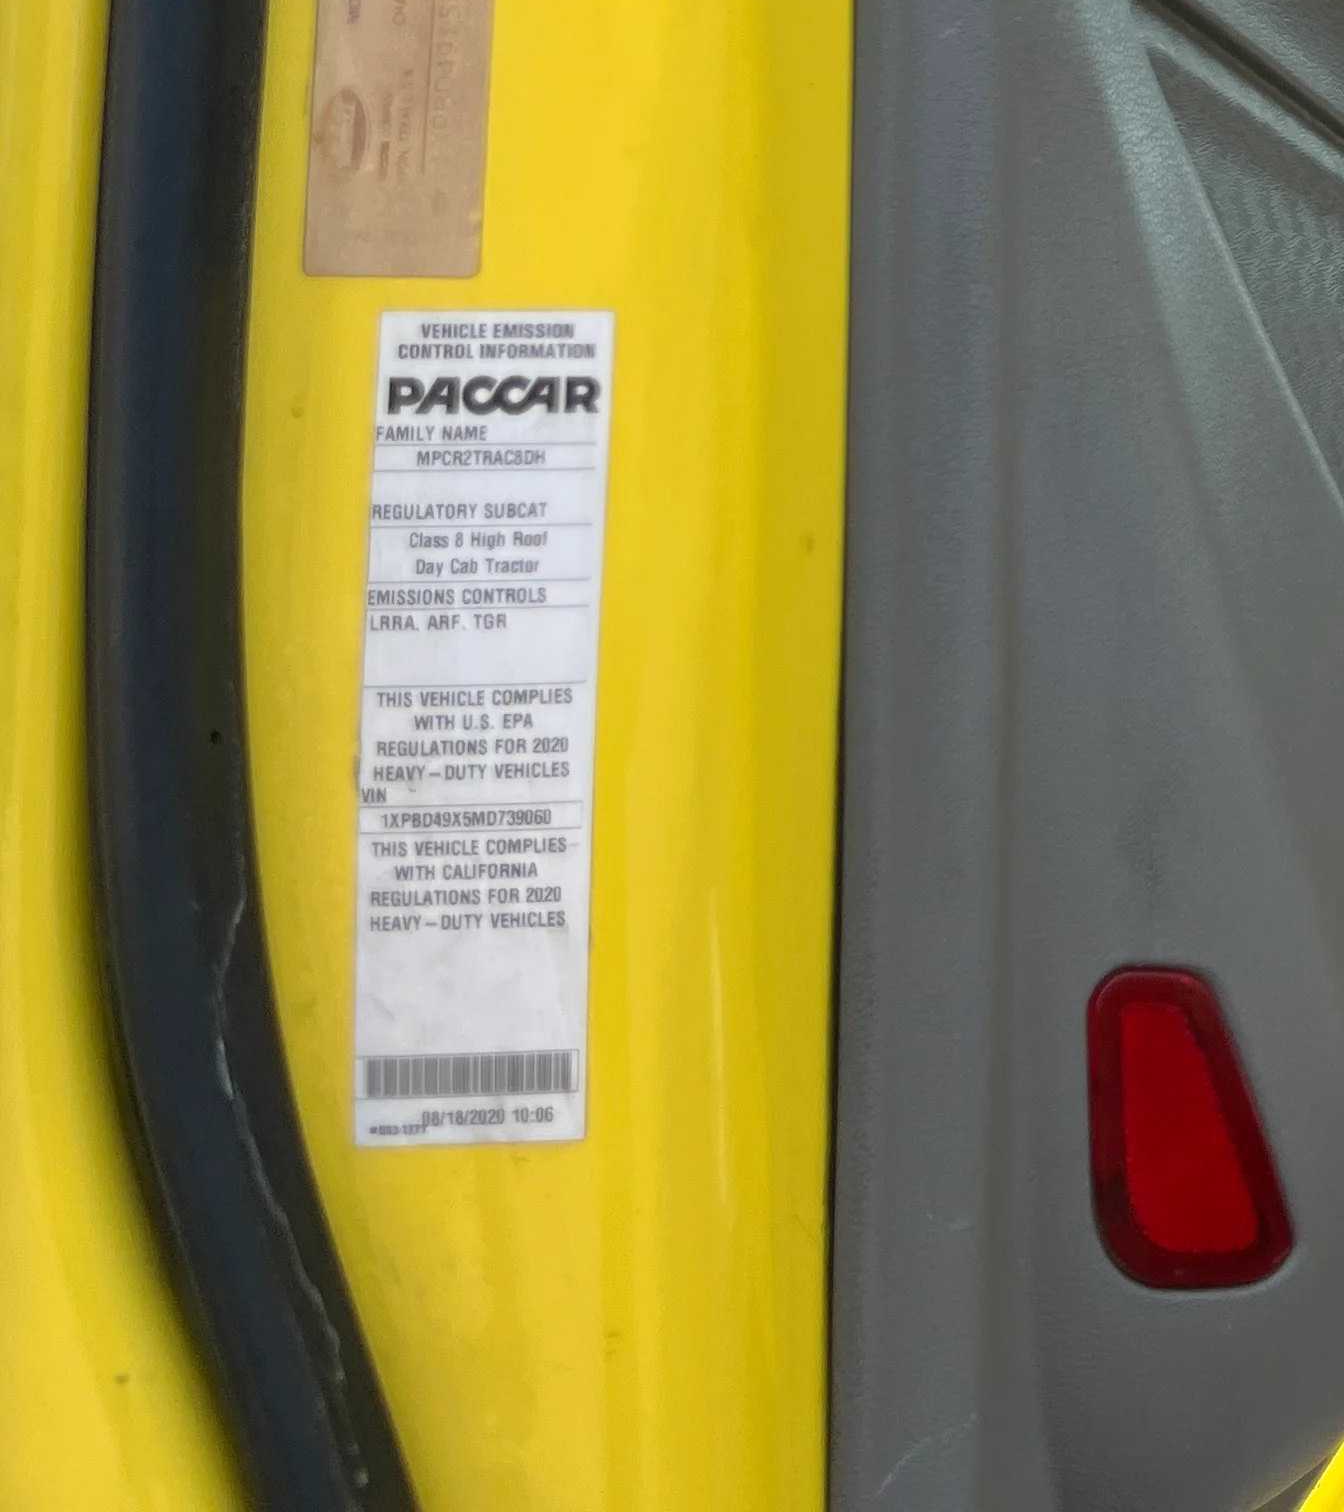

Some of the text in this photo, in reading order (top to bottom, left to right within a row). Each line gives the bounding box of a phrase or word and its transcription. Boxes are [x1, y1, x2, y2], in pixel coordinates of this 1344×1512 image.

[421, 323, 575, 338] VEHICLE EMISSION
[398, 343, 596, 359] CONTROL INFORMATION
[387, 375, 601, 415] PACCAR
[376, 425, 487, 441] FAMILY NAME
[372, 502, 548, 520] REGULATORY SUBCAT
[409, 530, 549, 550] Class 8 High Roof
[416, 558, 540, 577] Day Cab Tractor
[368, 587, 547, 606] EMISSIONS CONTROLS
[474, 613, 507, 629] TGR
[377, 688, 573, 708] THIS VEHICLE COMPLIES
[414, 713, 534, 730] WITH U.S. EPA
[376, 737, 569, 757] REGULATIONS FOR 2020
[494, 761, 570, 779] VEHICLES
[361, 788, 387, 803] VIN
[372, 837, 568, 858] THIS VEHICLE COMPLIES
[394, 863, 538, 881] WITH CALIFORNIA
[370, 886, 562, 908] REGULATIONS FOR 2020
[490, 911, 567, 930] VEHICLES
[422, 1106, 554, 1126] 08/18/2020 10:06
